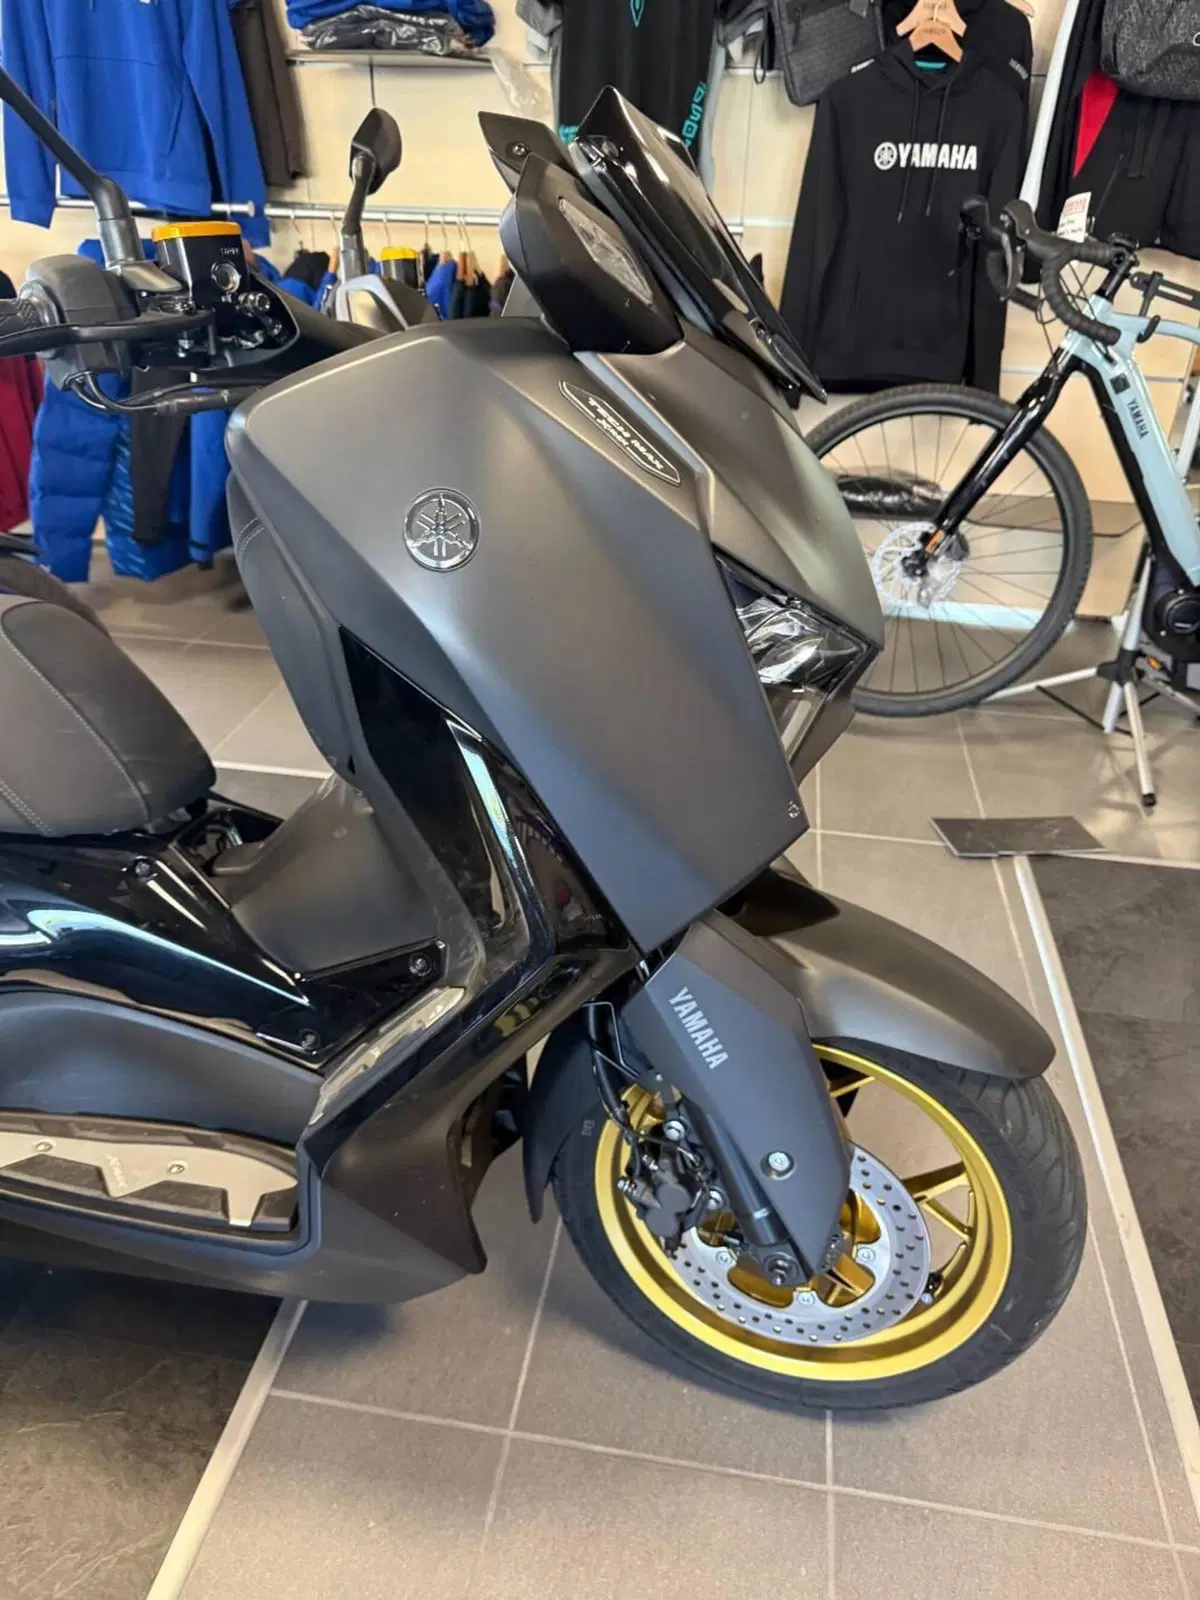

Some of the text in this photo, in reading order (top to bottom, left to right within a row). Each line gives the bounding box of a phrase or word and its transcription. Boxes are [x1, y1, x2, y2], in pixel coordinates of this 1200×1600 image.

[898, 142, 978, 171] YAMAHA
[588, 397, 664, 470] TECH MAX
[1126, 395, 1149, 440] YAMAHA
[668, 986, 729, 1070] YAMAHA
